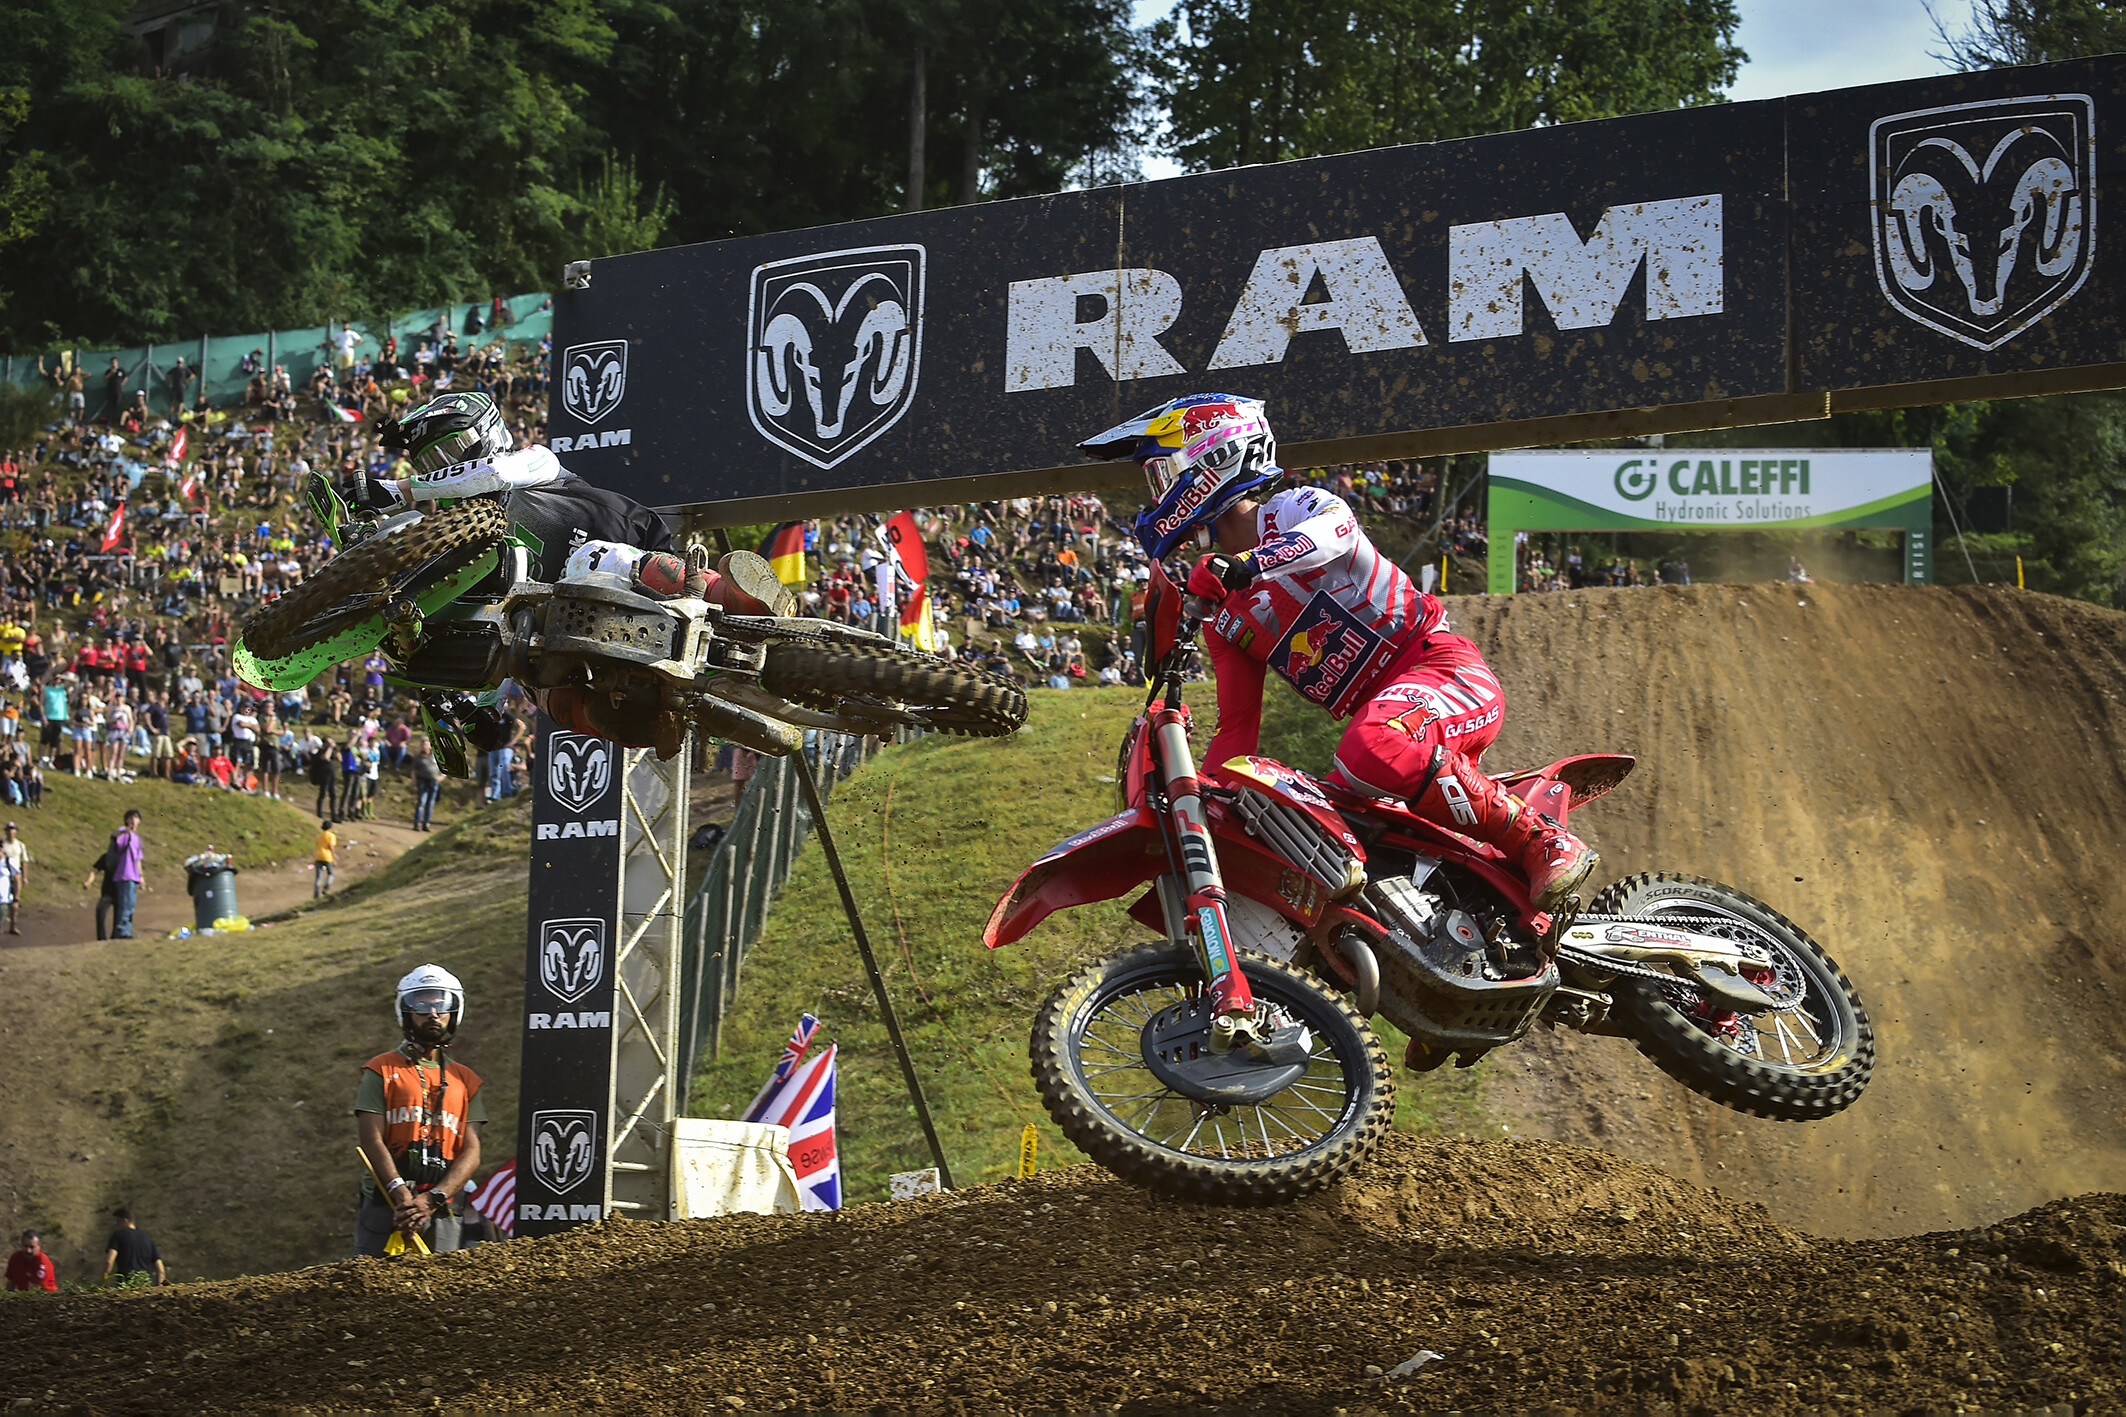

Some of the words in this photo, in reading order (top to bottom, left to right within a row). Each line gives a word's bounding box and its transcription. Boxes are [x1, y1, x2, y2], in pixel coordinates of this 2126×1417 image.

[1004, 193, 1724, 394] RAM
[551, 429, 631, 454] RAM
[1668, 460, 1810, 496] CALEFFI
[1656, 500, 1728, 523] Hydronic
[1736, 499, 1812, 519] Solutions
[1445, 705, 1499, 738] GASGAS
[536, 819, 618, 841] RAM
[1199, 908, 1222, 962] MOTOREX
[528, 1011, 611, 1030] RAM
[519, 1204, 602, 1222] RAM
